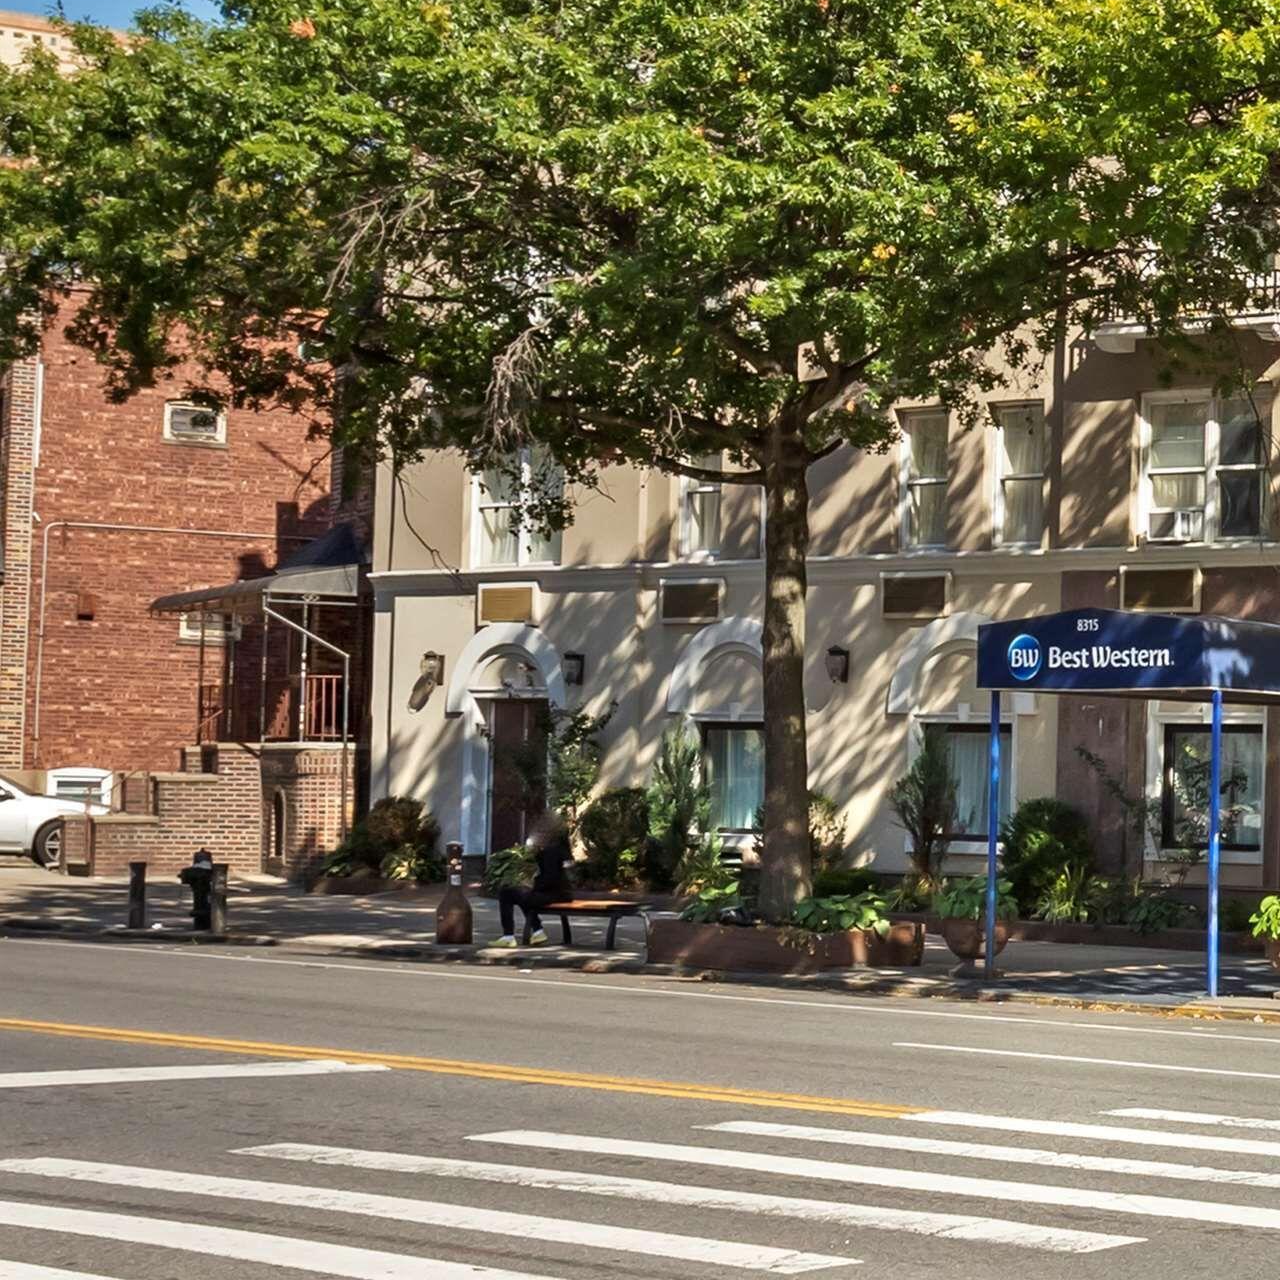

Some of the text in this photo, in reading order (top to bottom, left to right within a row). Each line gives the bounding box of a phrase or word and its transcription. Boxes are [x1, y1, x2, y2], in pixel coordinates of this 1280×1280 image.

[1076, 619, 1099, 631] 8315
[1010, 648, 1039, 668] BW
[1048, 646, 1089, 668] Best
